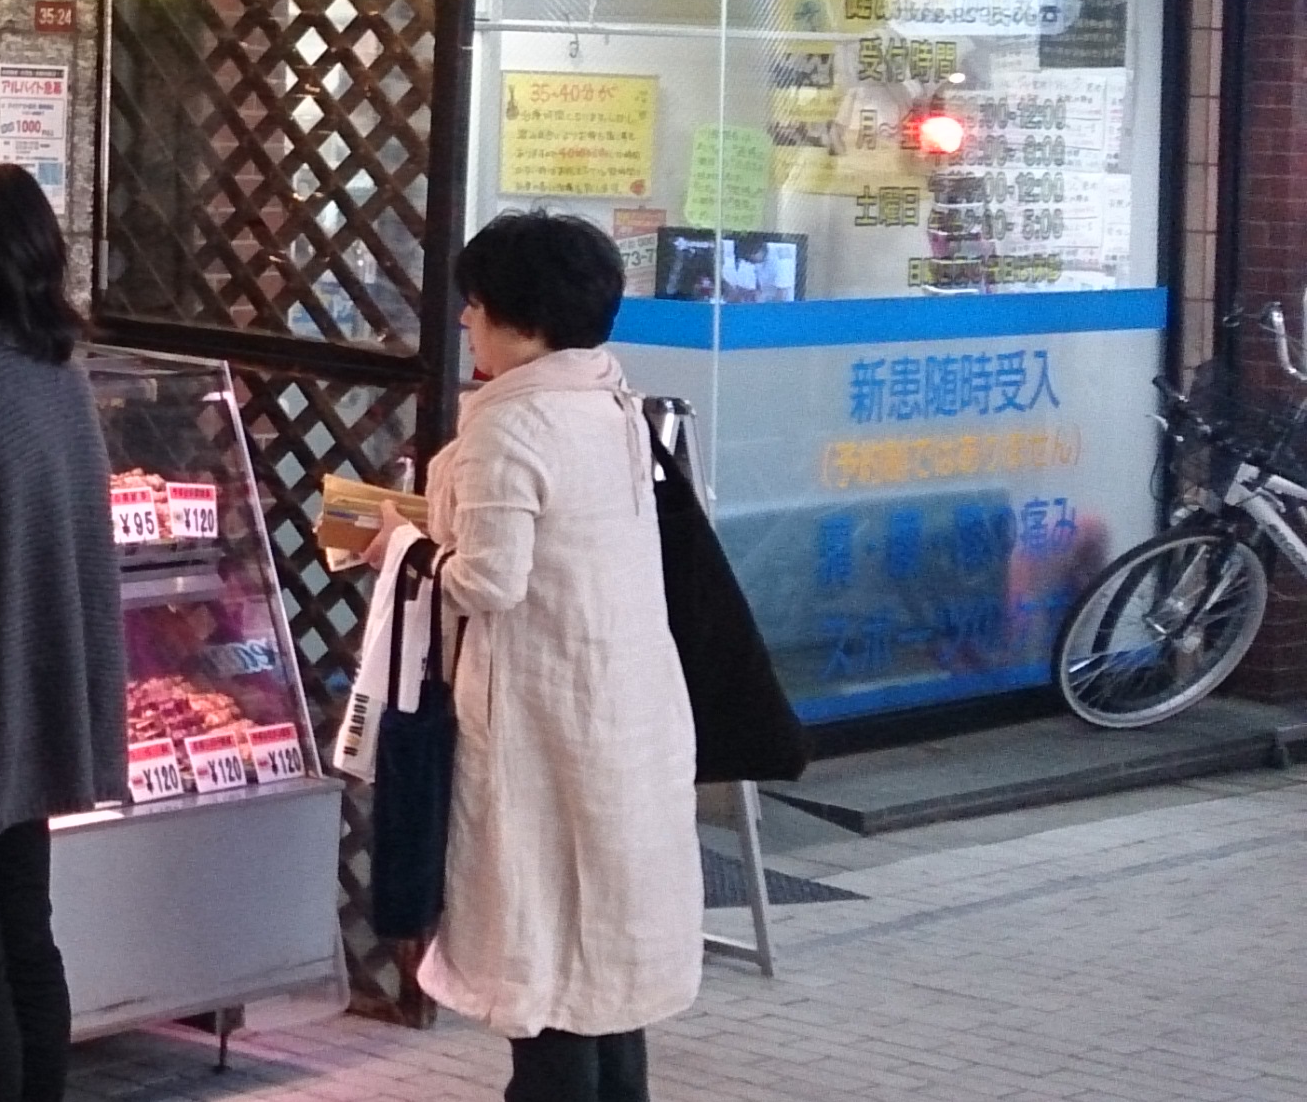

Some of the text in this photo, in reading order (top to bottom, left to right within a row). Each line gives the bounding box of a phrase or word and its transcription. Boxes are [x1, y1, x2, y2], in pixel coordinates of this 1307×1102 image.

[858, 37, 957, 83] 受付時間
[850, 351, 1060, 424] 新患随時受入
[184, 508, 215, 533] ¥120
[208, 755, 242, 785] ¥120
[268, 747, 301, 776] ¥120
[143, 764, 179, 795] ¥120
